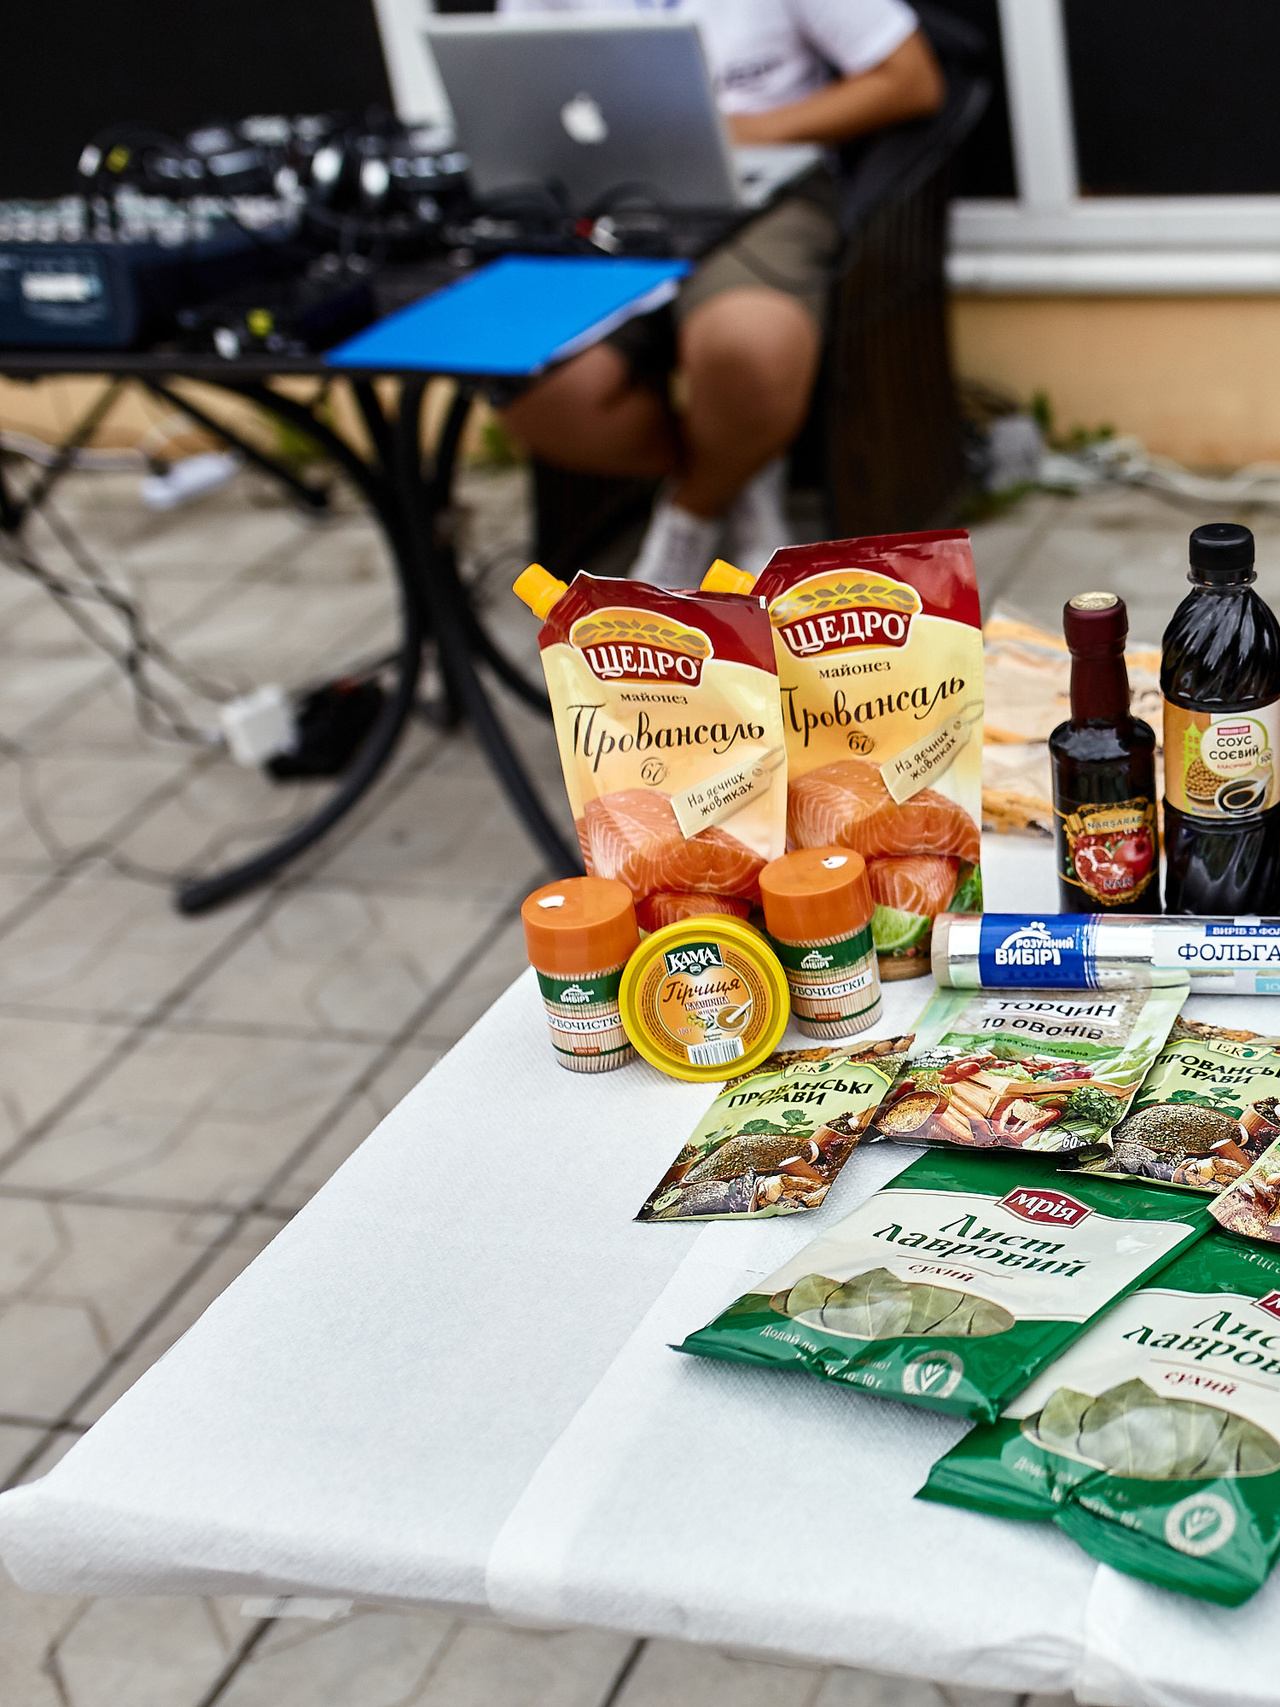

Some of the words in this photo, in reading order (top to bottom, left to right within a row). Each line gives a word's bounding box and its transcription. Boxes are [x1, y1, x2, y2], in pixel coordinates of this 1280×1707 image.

[782, 612, 906, 656] ЩЕДРО
[585, 645, 698, 681] ЩЕДРО
[818, 660, 892, 680] майонез
[620, 692, 689, 706] майонез
[779, 676, 966, 748] Провансаль
[566, 703, 765, 773] Провансаль
[1216, 735, 1252, 748] СОУС
[909, 735, 957, 781] жовтках
[1208, 744, 1259, 761] СОЄВИЙ
[894, 759, 912, 776] На
[686, 793, 705, 808] На
[699, 780, 754, 818] жовтках
[1212, 927, 1247, 936] ВИРІБ
[1249, 927, 1257, 936] З
[1015, 936, 1074, 949] РОЗУМНИЙ
[662, 978, 741, 1006] Гірчиця
[999, 1001, 1117, 1018] ТОРЧИН
[981, 1018, 1006, 1030] 10
[1011, 1019, 1105, 1041] ОВОЧІВ
[1181, 1066, 1254, 1084] ТРАВИ
[727, 1079, 874, 1109] ПРОВАНСЬКІ
[1062, 1134, 1079, 1149] 60
[938, 1213, 1067, 1256] Лист
[908, 1263, 977, 1283] сухий
[860, 1373, 876, 1387] 10
[1164, 1370, 1240, 1397] сухий
